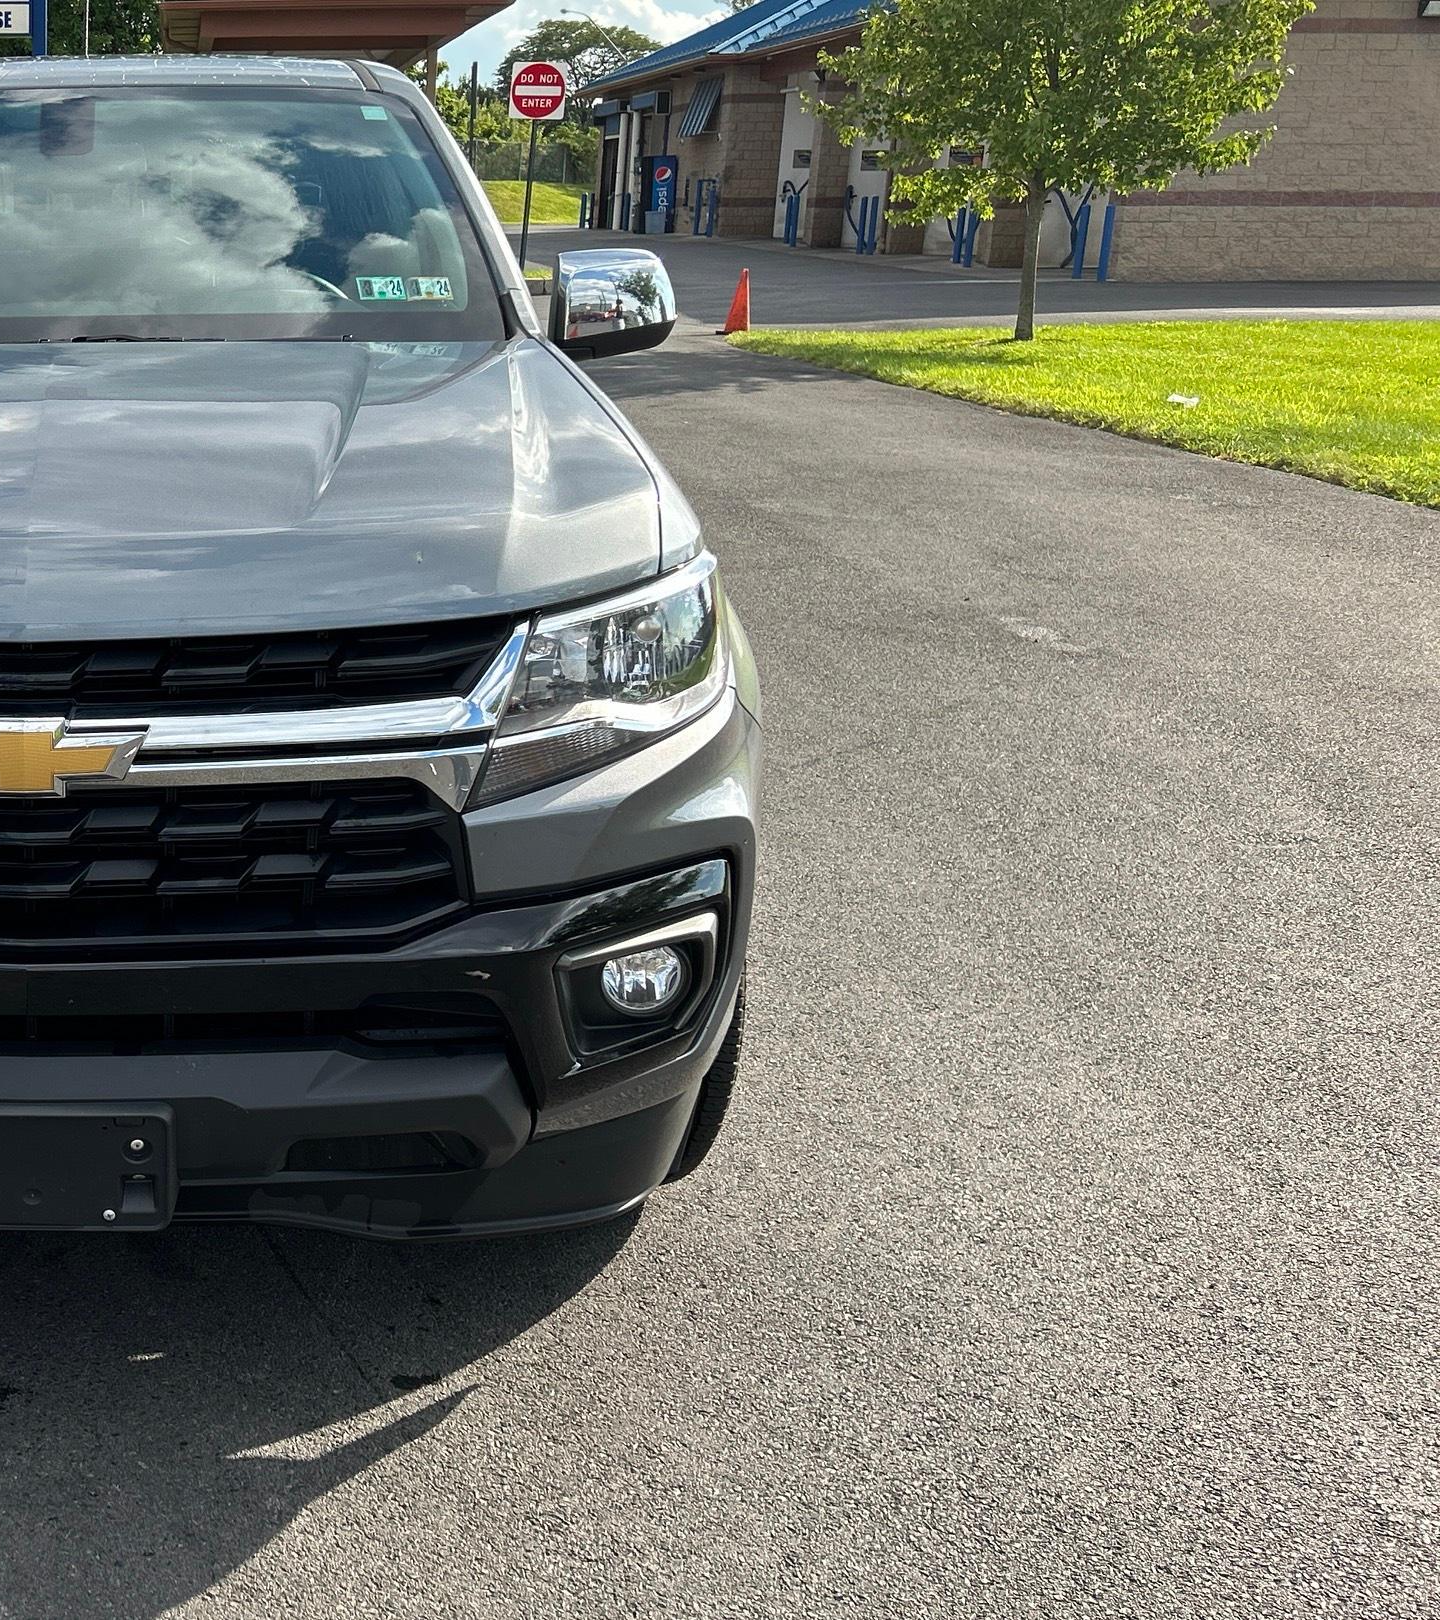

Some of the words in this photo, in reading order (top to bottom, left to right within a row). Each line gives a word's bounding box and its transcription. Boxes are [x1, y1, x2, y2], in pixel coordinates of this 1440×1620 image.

[520, 74, 534, 83] DO
[540, 74, 558, 83] NOT
[522, 98, 552, 108] ENTER
[656, 187, 670, 213] epsi
[389, 280, 403, 296] 24
[436, 280, 450, 296] 24
